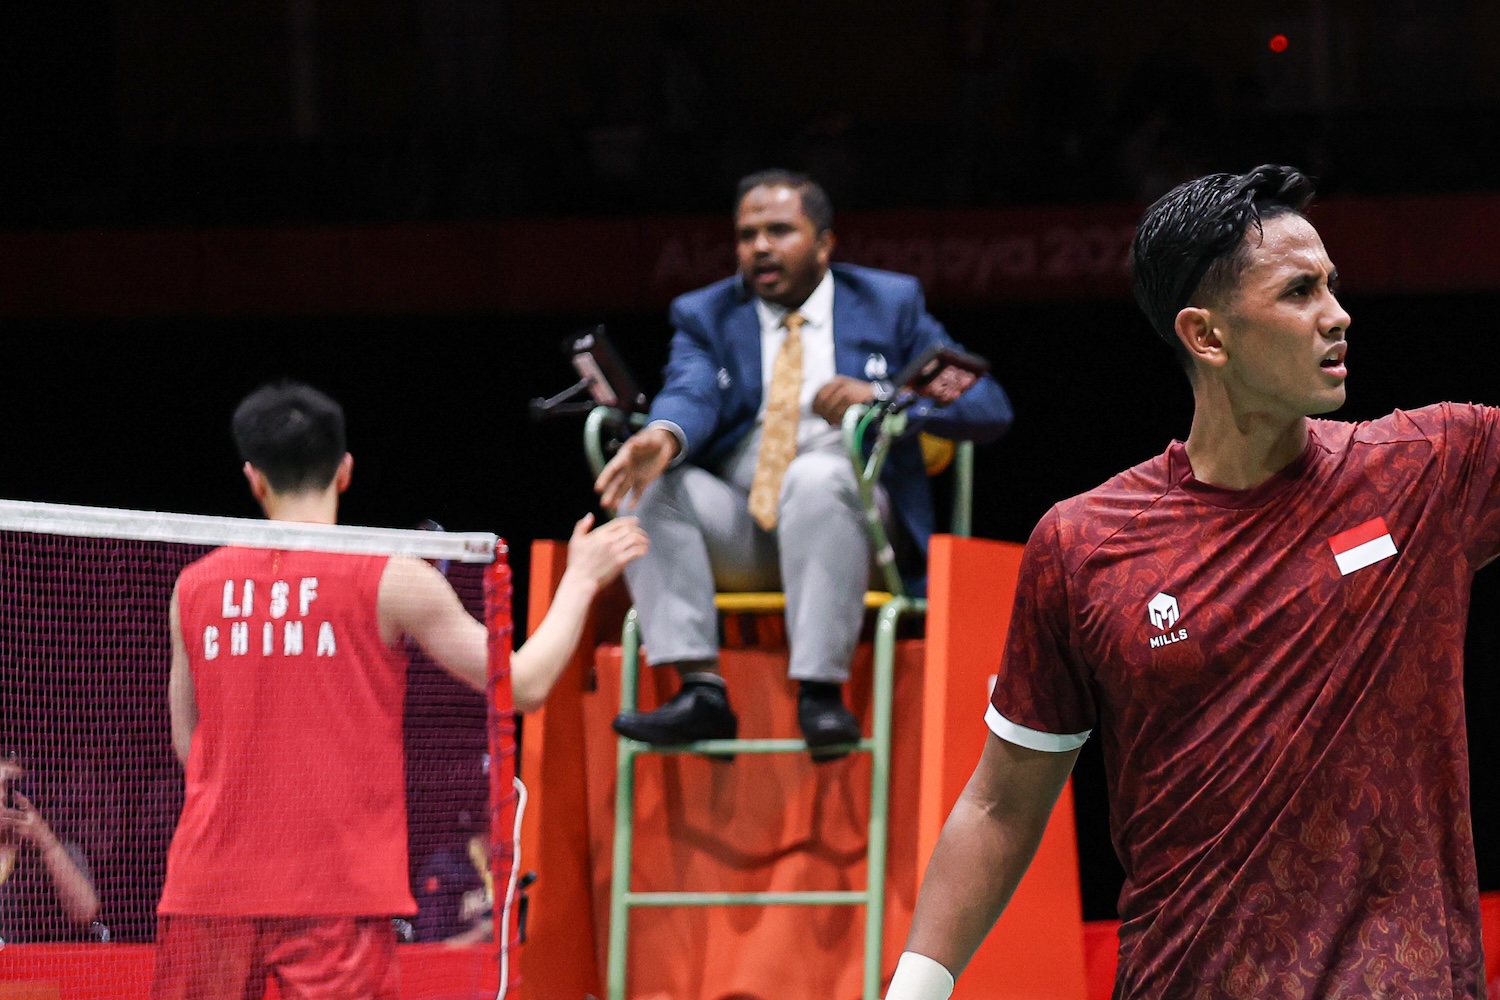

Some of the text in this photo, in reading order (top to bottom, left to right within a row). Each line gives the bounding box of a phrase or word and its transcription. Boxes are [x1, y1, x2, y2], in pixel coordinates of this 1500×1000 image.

[222, 577, 319, 619] LI S F
[203, 620, 337, 661] CHINA
[1149, 628, 1188, 649] MILLS
